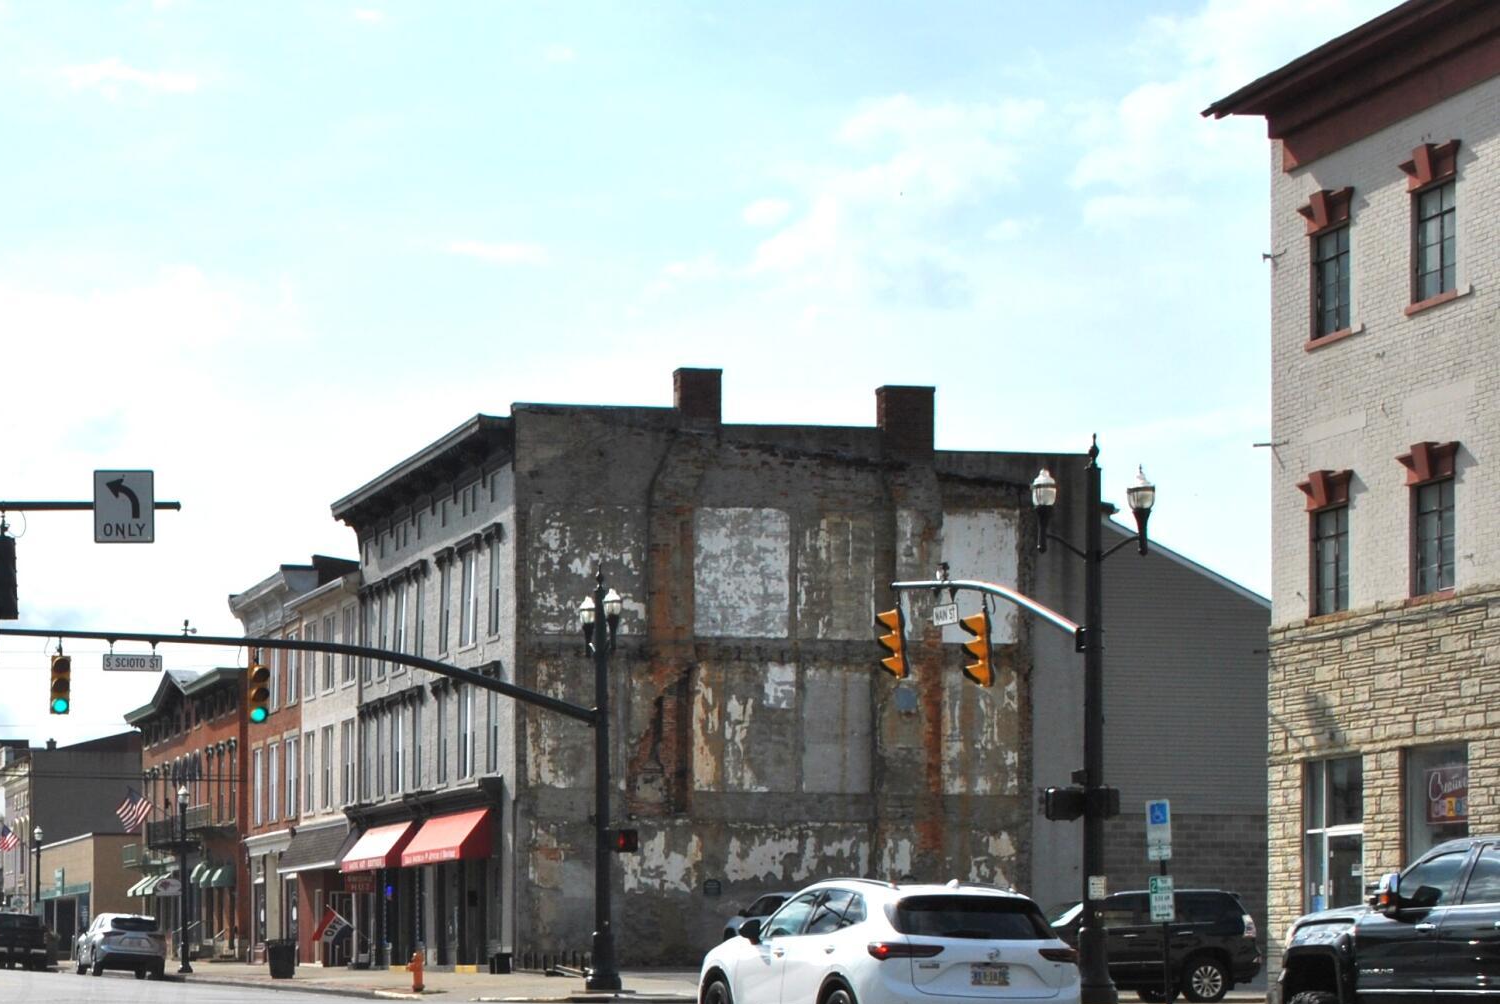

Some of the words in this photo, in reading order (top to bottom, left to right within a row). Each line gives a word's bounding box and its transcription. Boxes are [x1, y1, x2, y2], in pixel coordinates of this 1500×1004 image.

[103, 522, 146, 538] ONLY
[105, 657, 111, 668] S
[115, 657, 146, 668] SCIOTO
[150, 658, 159, 669] ST
